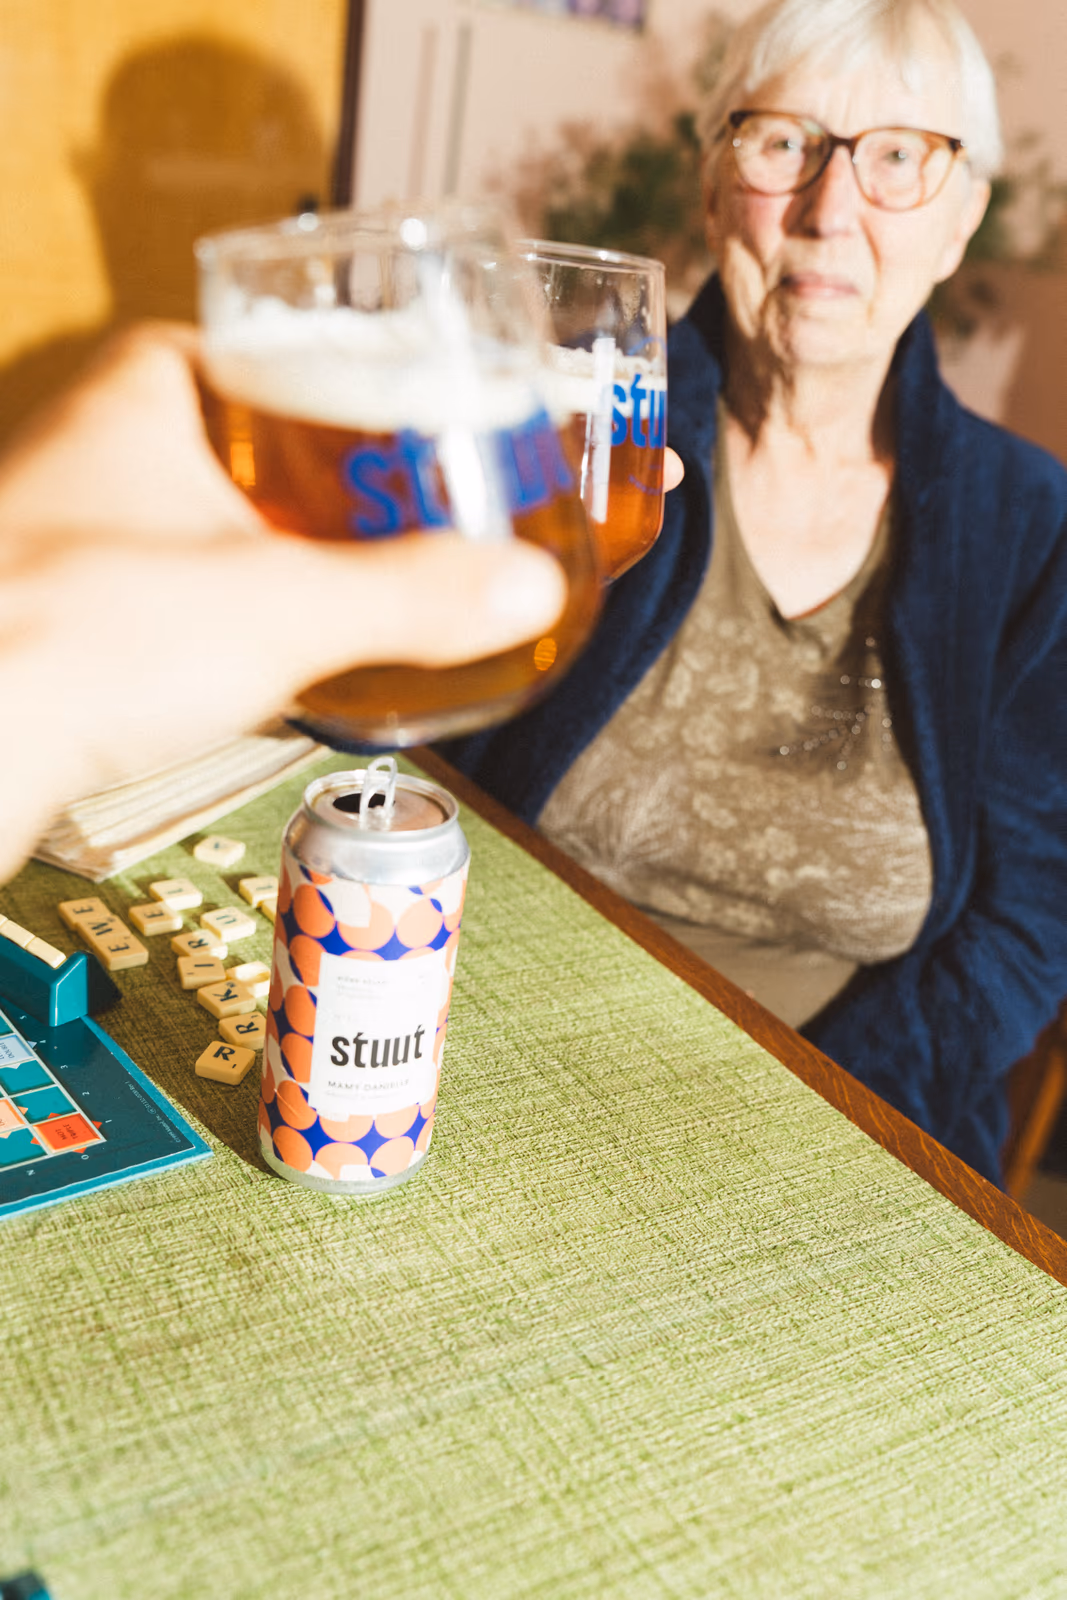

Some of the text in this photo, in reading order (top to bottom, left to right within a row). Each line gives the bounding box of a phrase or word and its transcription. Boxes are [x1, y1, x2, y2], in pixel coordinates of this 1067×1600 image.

[107, 943, 131, 953] E
[188, 938, 209, 949] R
[212, 988, 239, 1003] K
[235, 1021, 260, 1035] R
[213, 1045, 236, 1061] R
[330, 1023, 426, 1069] stuut
[55, 1129, 67, 1140] MOT
[62, 1123, 78, 1139] TRIPLE
